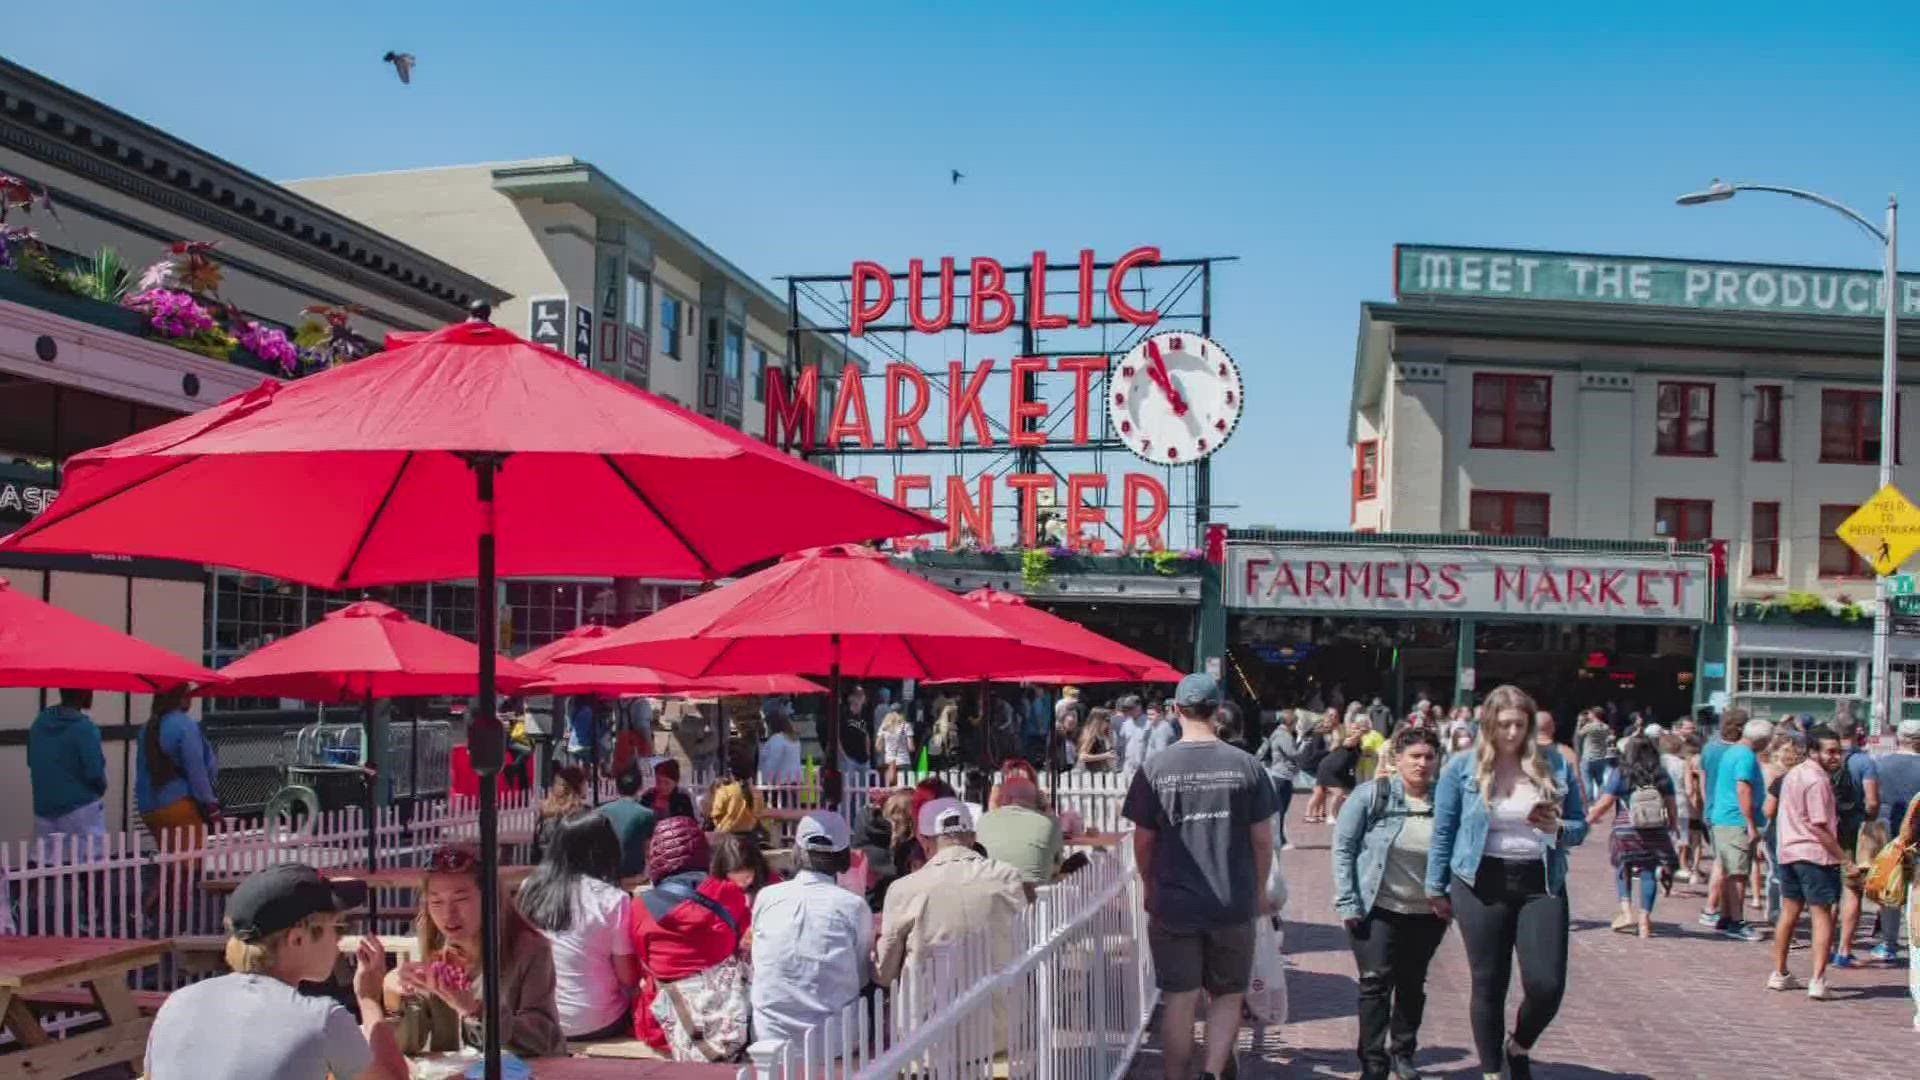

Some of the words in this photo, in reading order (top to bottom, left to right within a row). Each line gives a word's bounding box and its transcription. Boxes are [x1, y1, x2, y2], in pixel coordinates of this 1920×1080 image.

[850, 246, 1162, 337] PUBLIC
[1419, 254, 1541, 292] MEET
[1568, 263, 1652, 299] THE
[1169, 337, 1183, 351] 12
[765, 356, 1109, 452] MARKET
[850, 473, 1169, 554] ENTER
[1245, 558, 1464, 602] FARMERS
[1494, 564, 1689, 607] MARKET
